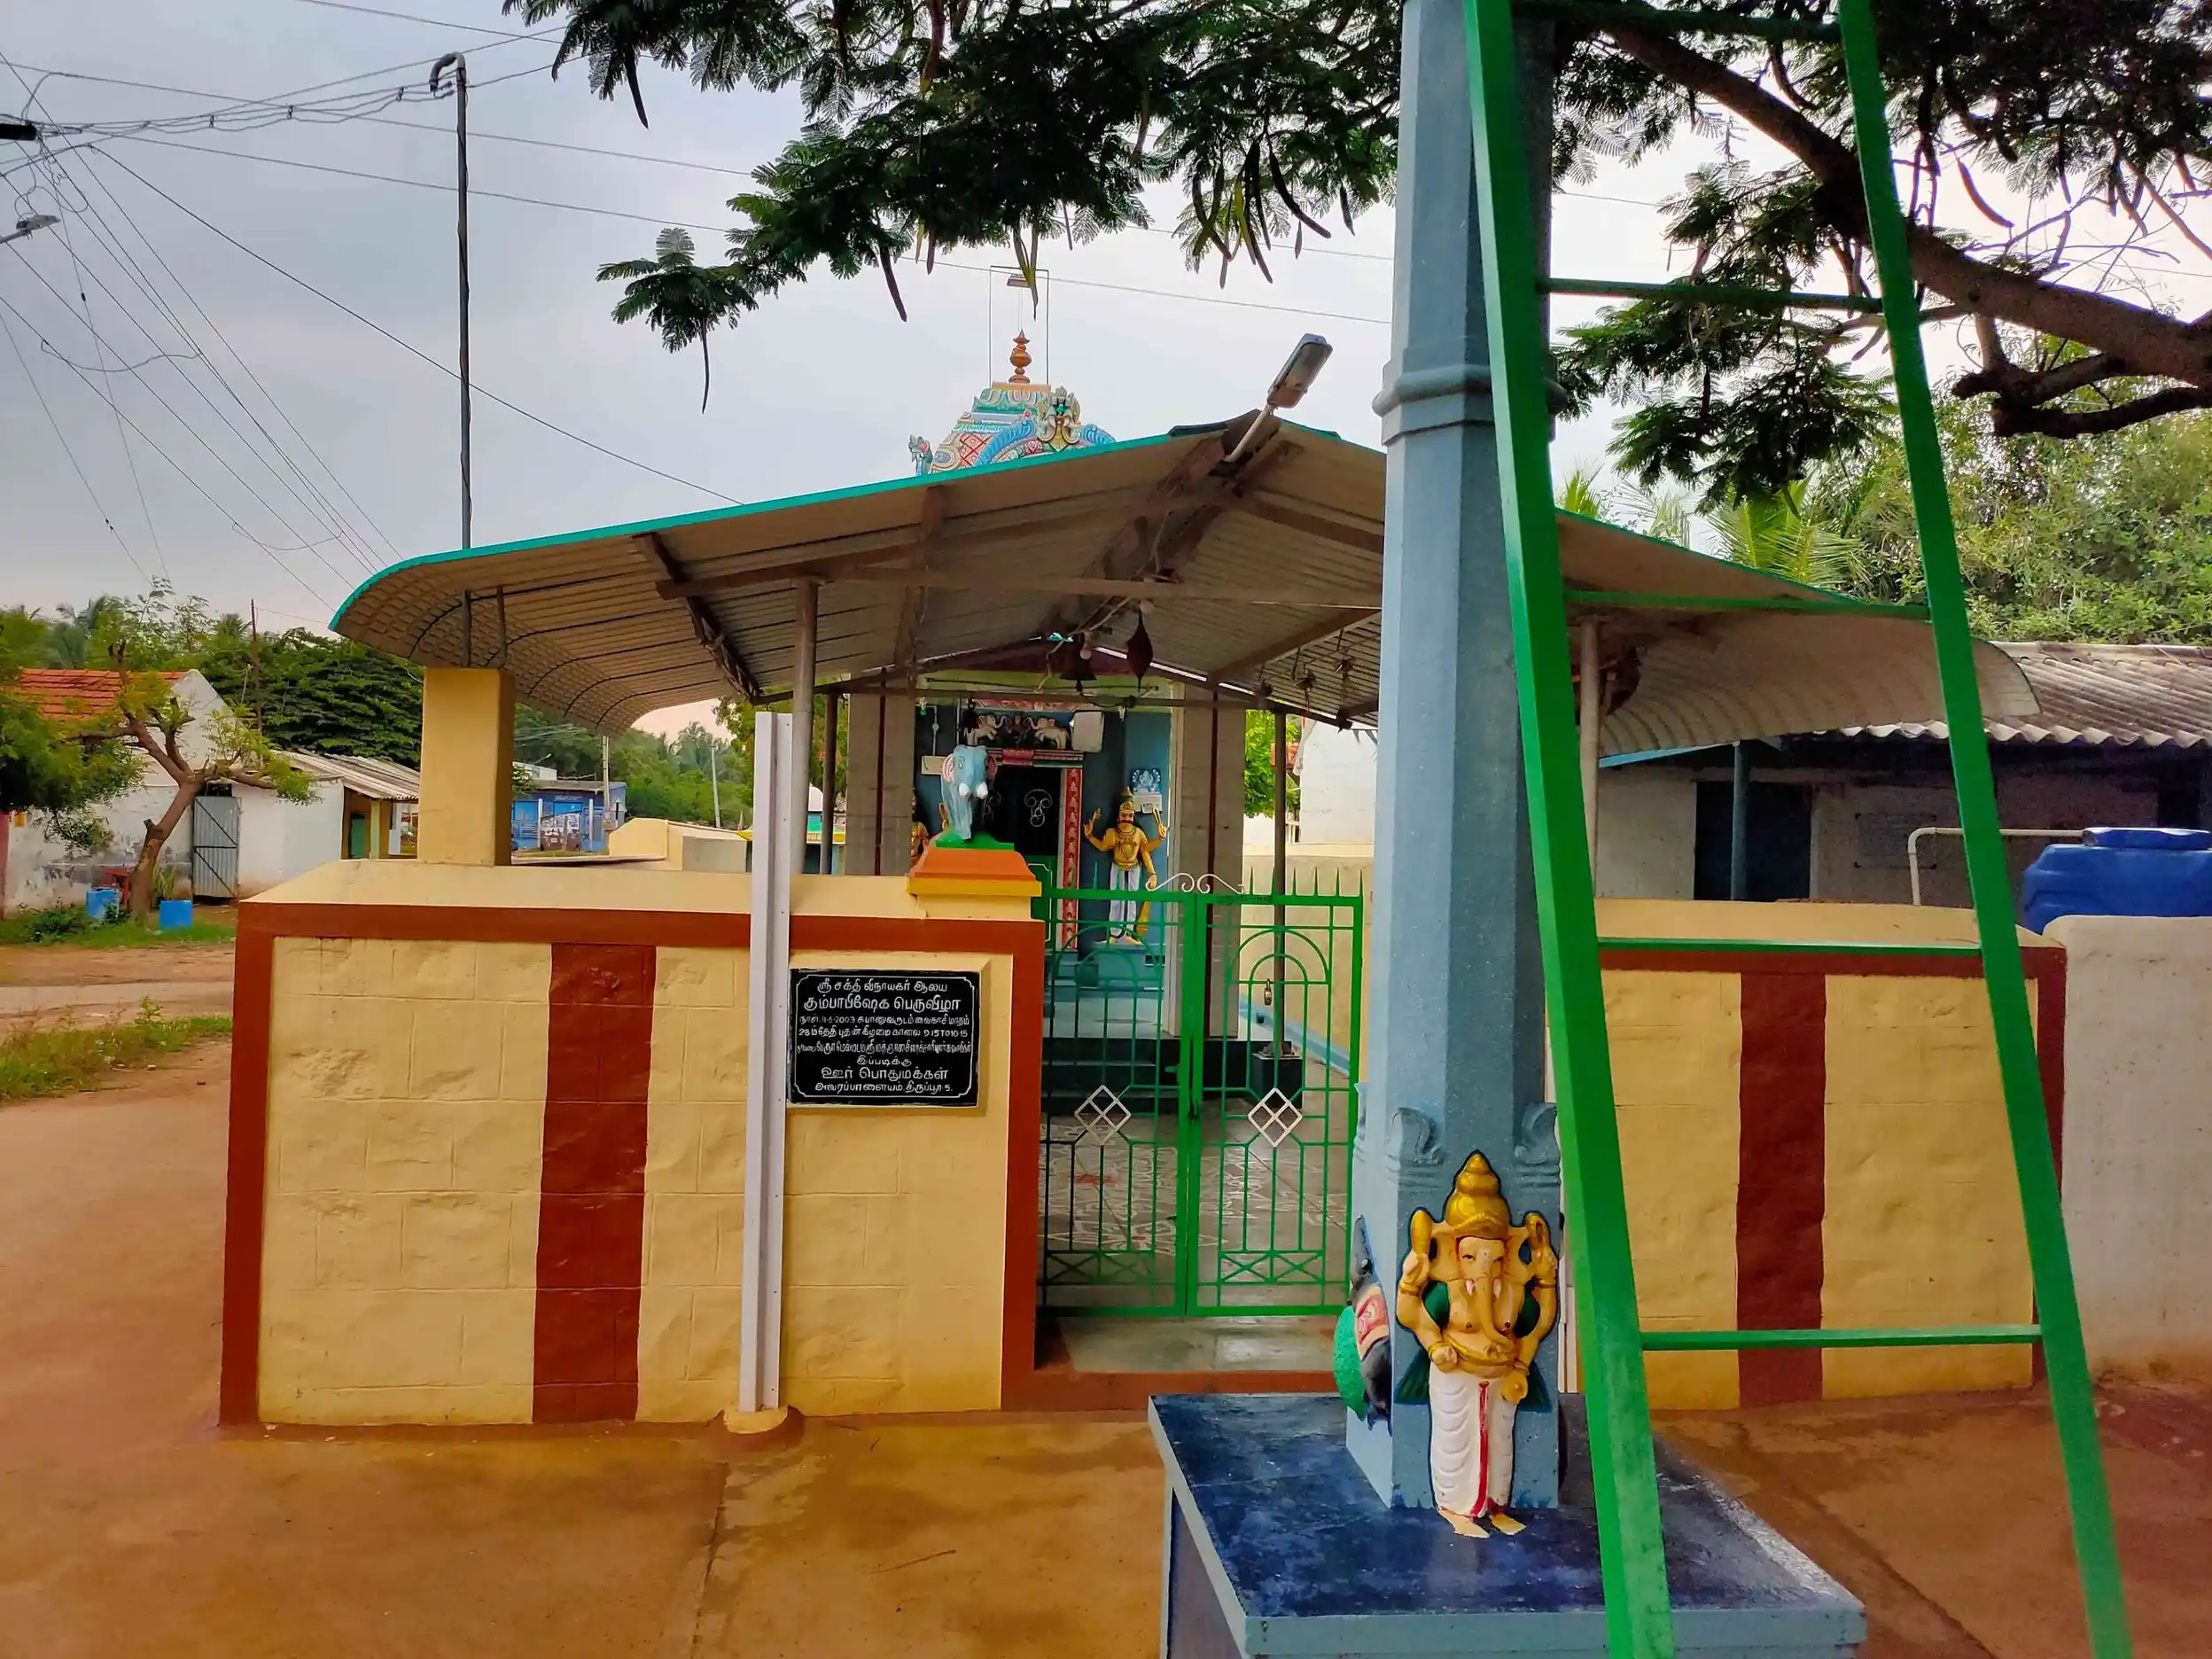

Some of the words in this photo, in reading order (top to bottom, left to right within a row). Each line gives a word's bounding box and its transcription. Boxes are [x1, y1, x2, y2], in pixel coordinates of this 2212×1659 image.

[834, 977, 861, 993] சக்தி
[864, 977, 910, 993] விநாயகர்
[914, 980, 947, 993] ஆலய
[804, 993, 890, 1013] கும்பாபிஷேக
[893, 994, 962, 1013] பெருவிழா
[856, 1055, 912, 1067] இப்படிக்கு
[821, 1066, 853, 1079] ஊர்
[859, 1066, 949, 1082] பொதுமக்கள்
